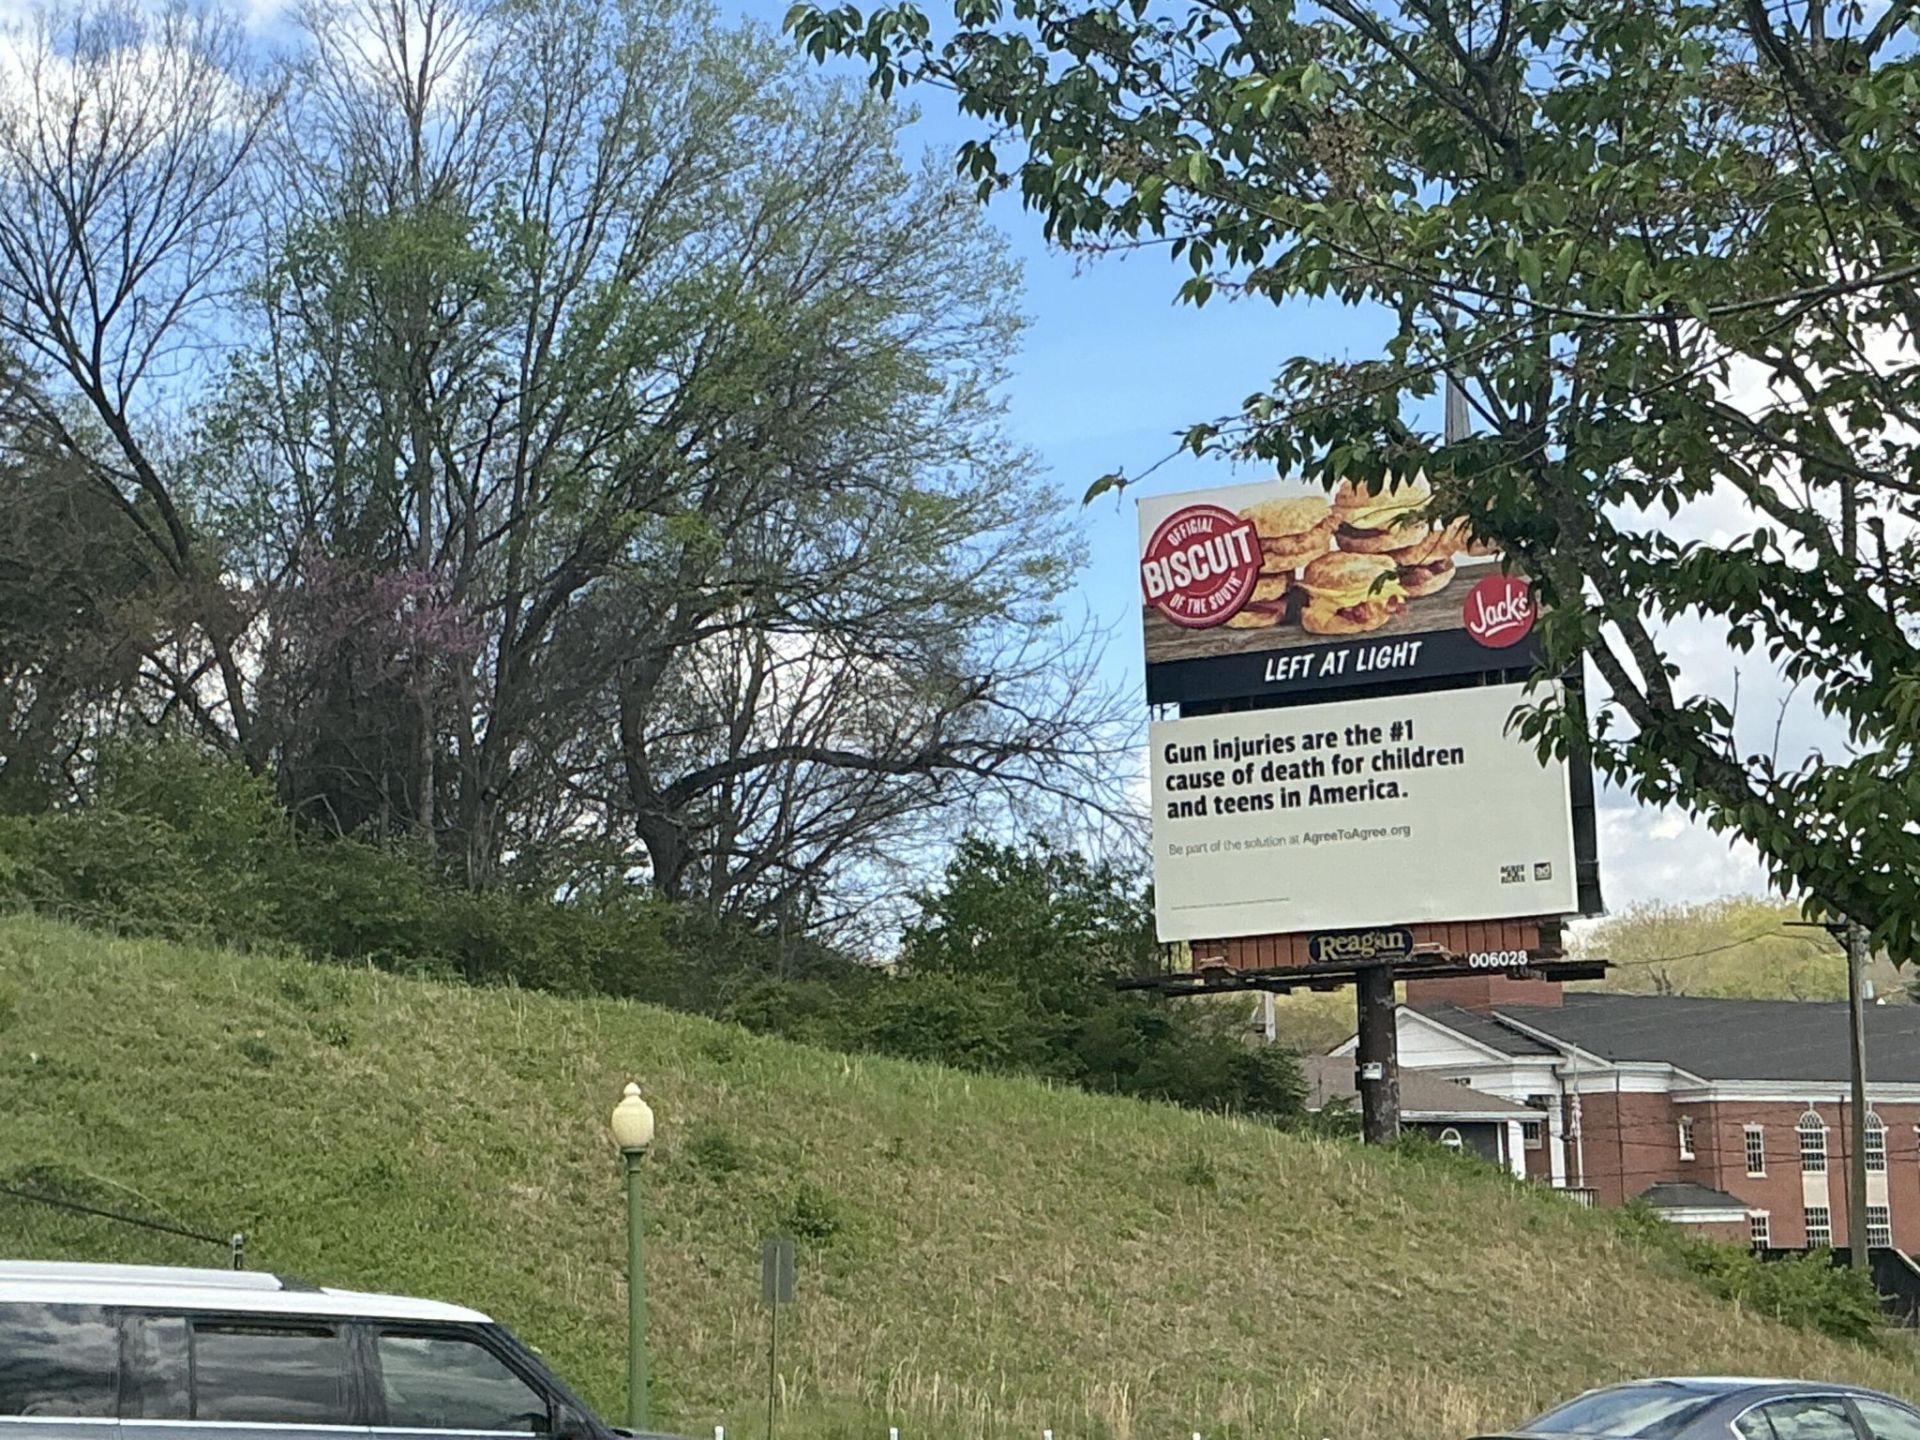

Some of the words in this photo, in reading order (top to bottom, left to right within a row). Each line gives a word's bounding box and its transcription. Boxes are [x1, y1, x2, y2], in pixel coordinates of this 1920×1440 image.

[1167, 517, 1213, 546] OFFICIAL
[1142, 525, 1252, 598] BISCUIT
[1169, 593, 1186, 610] OF
[1187, 598, 1207, 614] THE
[1208, 570, 1242, 610] SOUTH
[1470, 583, 1531, 634] Jack's
[1265, 653, 1315, 682] LEFT
[1319, 650, 1350, 677] AT
[1356, 641, 1422, 672] LIGHT
[1164, 743, 1207, 764] Gun
[1213, 733, 1296, 762] injuries
[1302, 731, 1338, 751] are
[1344, 724, 1382, 747] the
[1389, 719, 1413, 743] #1
[1166, 770, 1225, 791] cause
[1232, 762, 1254, 785] of
[1261, 756, 1325, 783] death
[1332, 753, 1364, 776] for
[1371, 745, 1464, 772] children
[1167, 795, 1207, 819] and
[1214, 792, 1274, 815] teens
[1280, 787, 1301, 808] in
[1308, 778, 1409, 806] America.
[1169, 844, 1183, 856] Be
[1185, 843, 1208, 857] part
[1210, 840, 1221, 853] of
[1223, 839, 1242, 852] the
[1244, 835, 1286, 850] solution
[1289, 834, 1299, 845] at
[1317, 931, 1405, 962] Reagan
[1469, 950, 1528, 968] 006028
